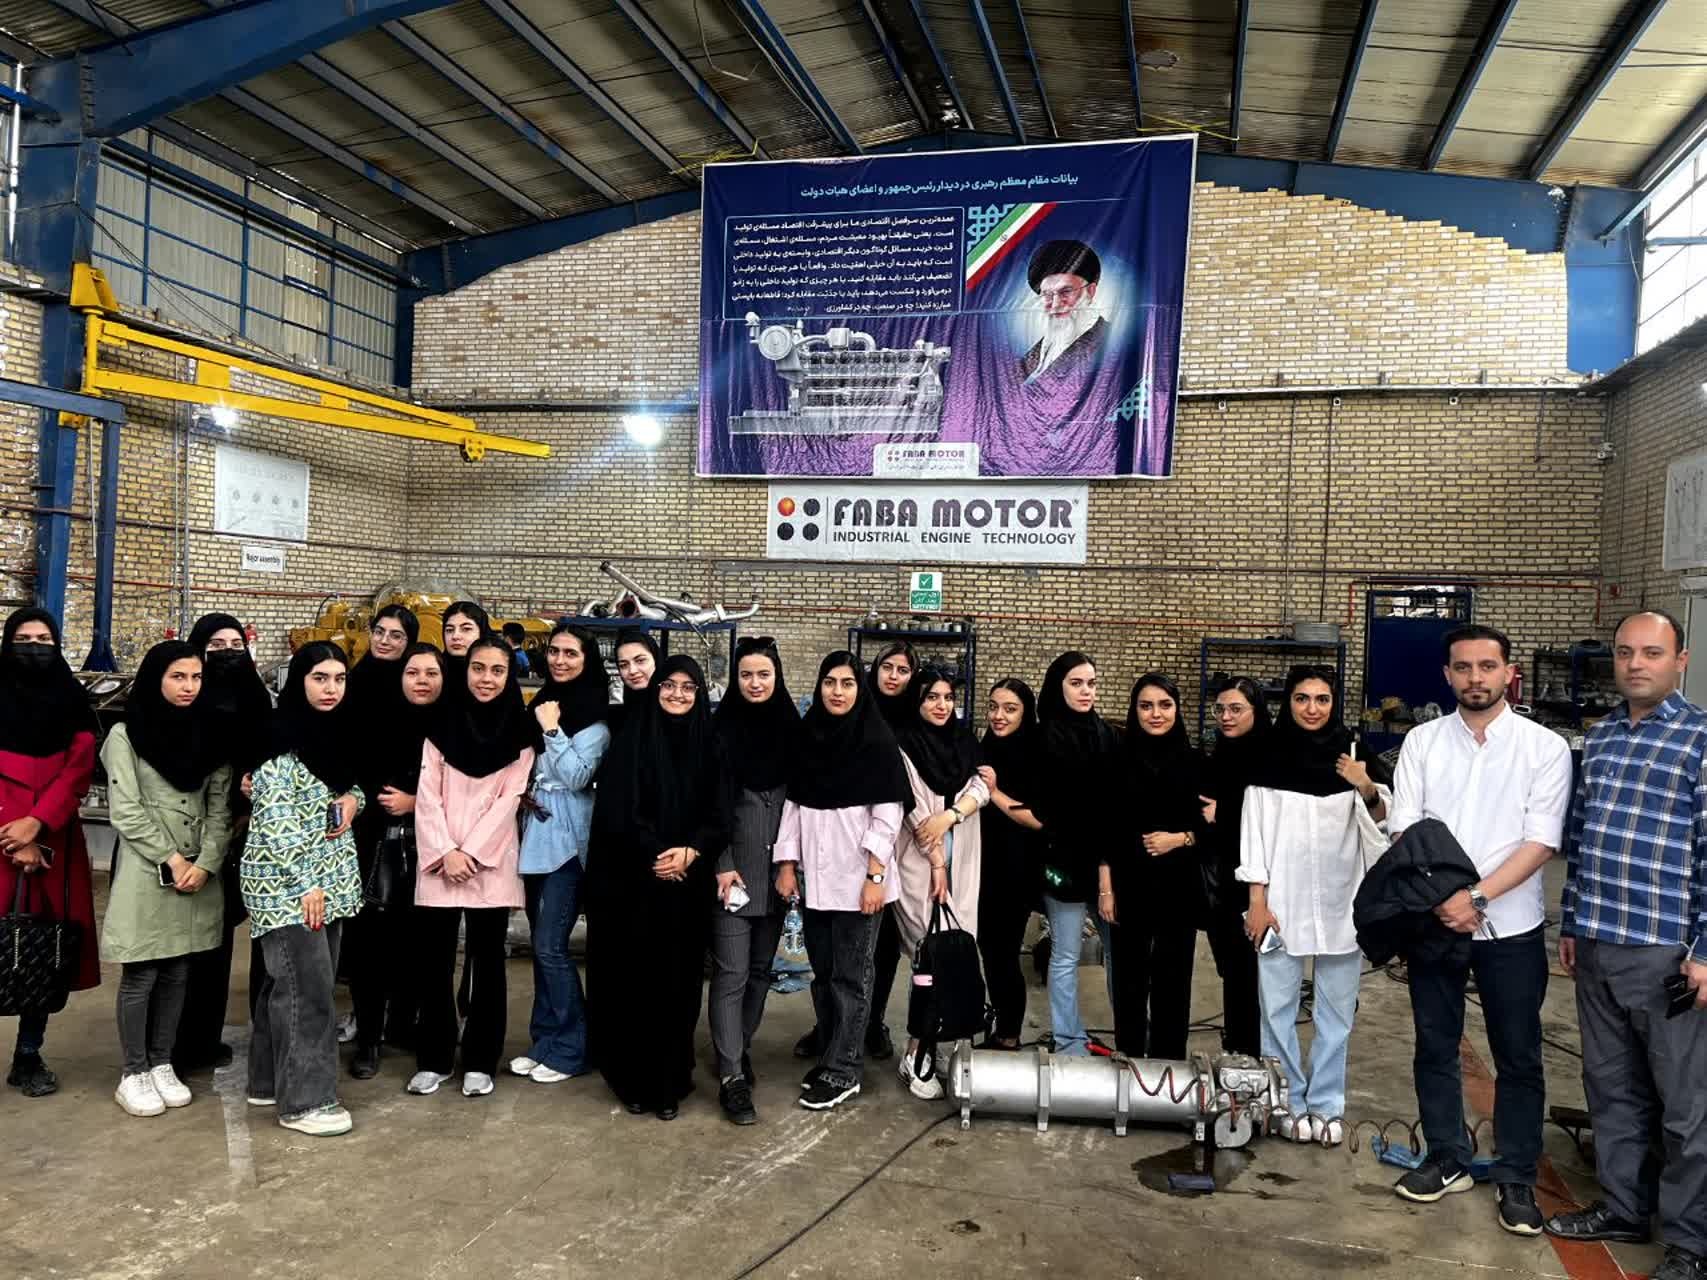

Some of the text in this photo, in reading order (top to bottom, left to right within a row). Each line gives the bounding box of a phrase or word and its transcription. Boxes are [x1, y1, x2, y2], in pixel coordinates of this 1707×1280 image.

[1000, 176, 1026, 190] معظم
[1028, 175, 1049, 188] مقام
[1050, 173, 1078, 184] بیانات
[848, 184, 877, 196] اعضای
[936, 180, 959, 192] دیدار
[960, 180, 970, 191] در
[972, 179, 998, 190] رهبری
[800, 187, 824, 198] دولت
[781, 221, 804, 230] اقتصاد
[861, 217, 890, 227] اقتصادی
[734, 224, 753, 232] تولید
[834, 498, 1072, 529] FABA MOTOR
[833, 531, 1076, 546] INDUSTRIAL ENGINE TECHNOLOGY
